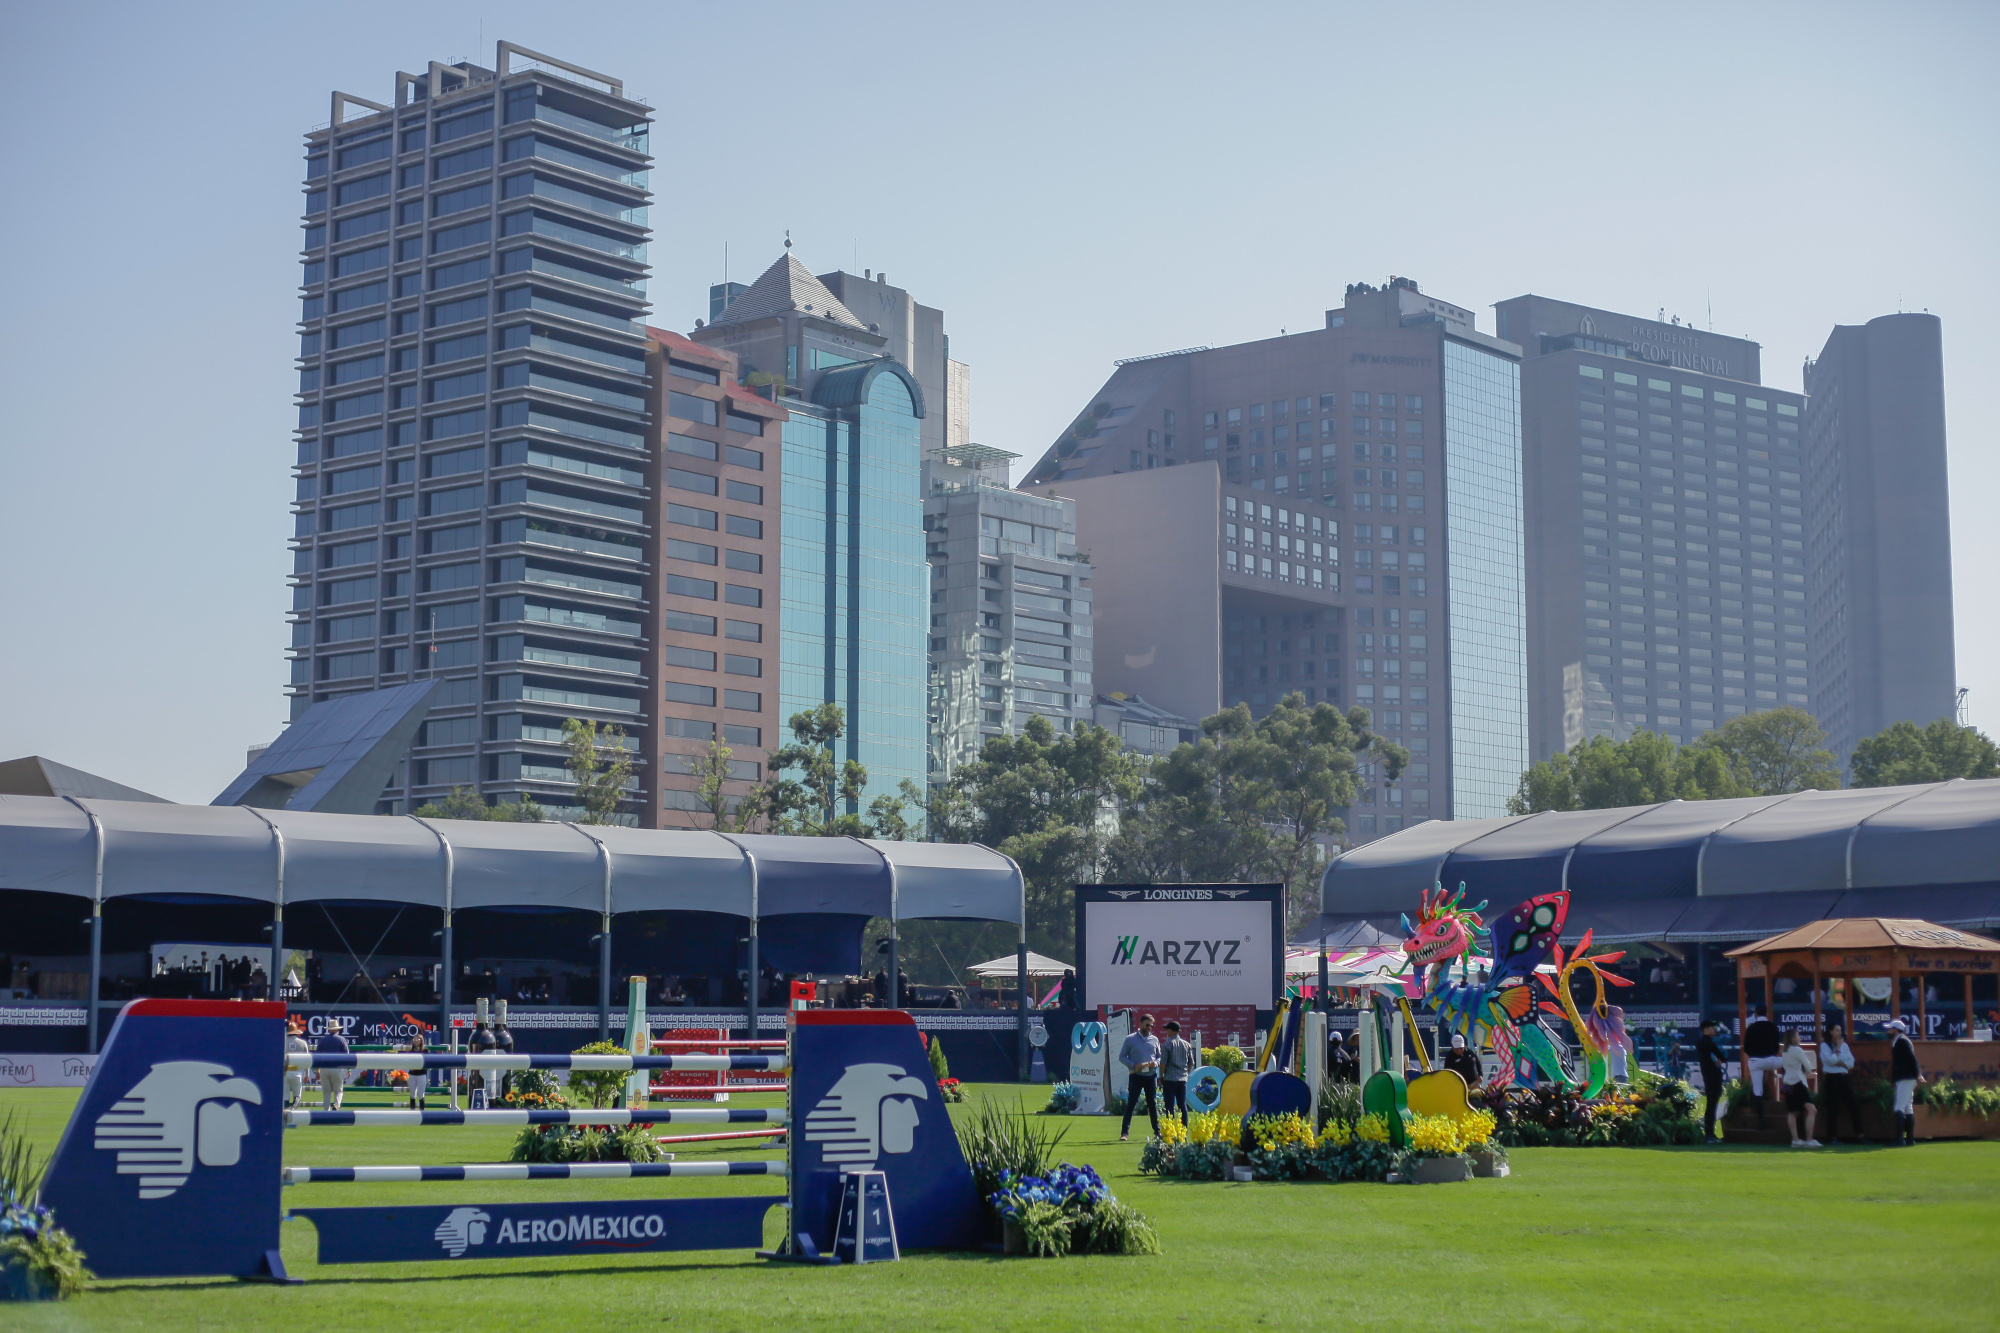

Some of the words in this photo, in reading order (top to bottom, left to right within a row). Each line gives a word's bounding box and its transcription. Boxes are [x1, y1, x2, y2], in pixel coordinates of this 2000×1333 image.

[879, 292, 897, 313] W
[1632, 325, 1700, 349] PRESIDENTE
[1350, 353, 1369, 363] JW
[1371, 355, 1433, 368] MARRIOTT
[1144, 889, 1213, 900] LONGINES
[1139, 940, 1241, 965] ARZYZ
[1166, 969, 1199, 977] BEYOND
[1200, 969, 1242, 977] ALUMINUM
[308, 1016, 356, 1036] GNP
[1781, 1014, 1826, 1023] LONGINS
[363, 1024, 419, 1037] MEXICO
[476, 1101, 481, 1109] 2
[847, 1209, 853, 1226] 1
[872, 1208, 880, 1226] 1
[496, 1214, 664, 1244] AEROMEXICO
